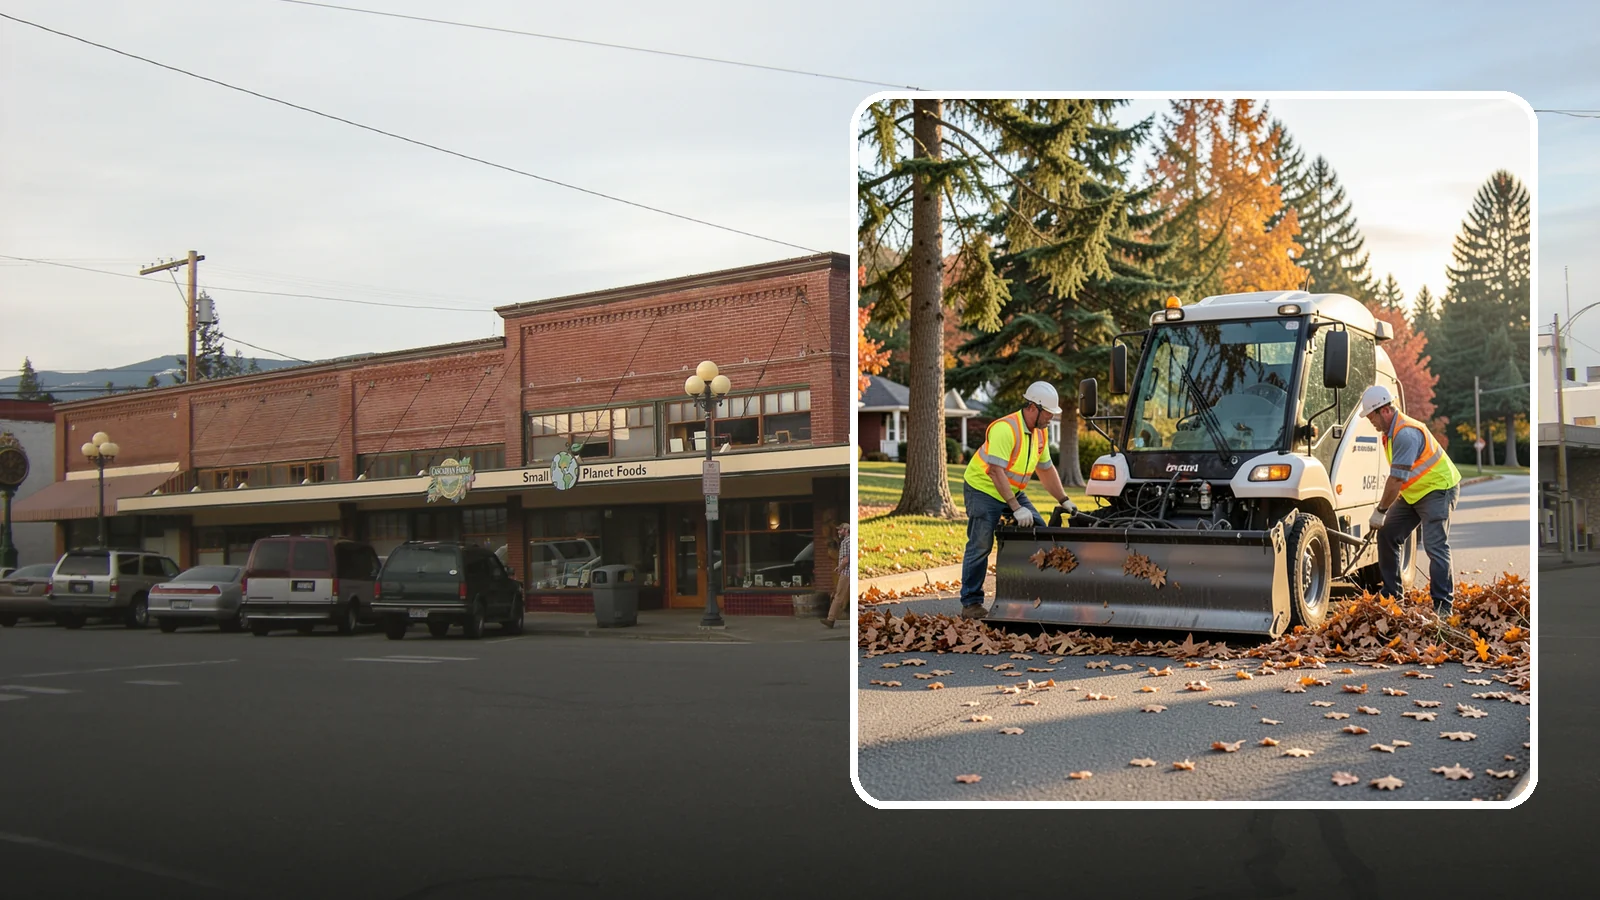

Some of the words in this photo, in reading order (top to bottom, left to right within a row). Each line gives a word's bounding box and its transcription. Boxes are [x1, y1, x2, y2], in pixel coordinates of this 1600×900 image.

[523, 471, 549, 483] Small
[582, 467, 614, 480] Planet
[616, 464, 647, 477] Foods
